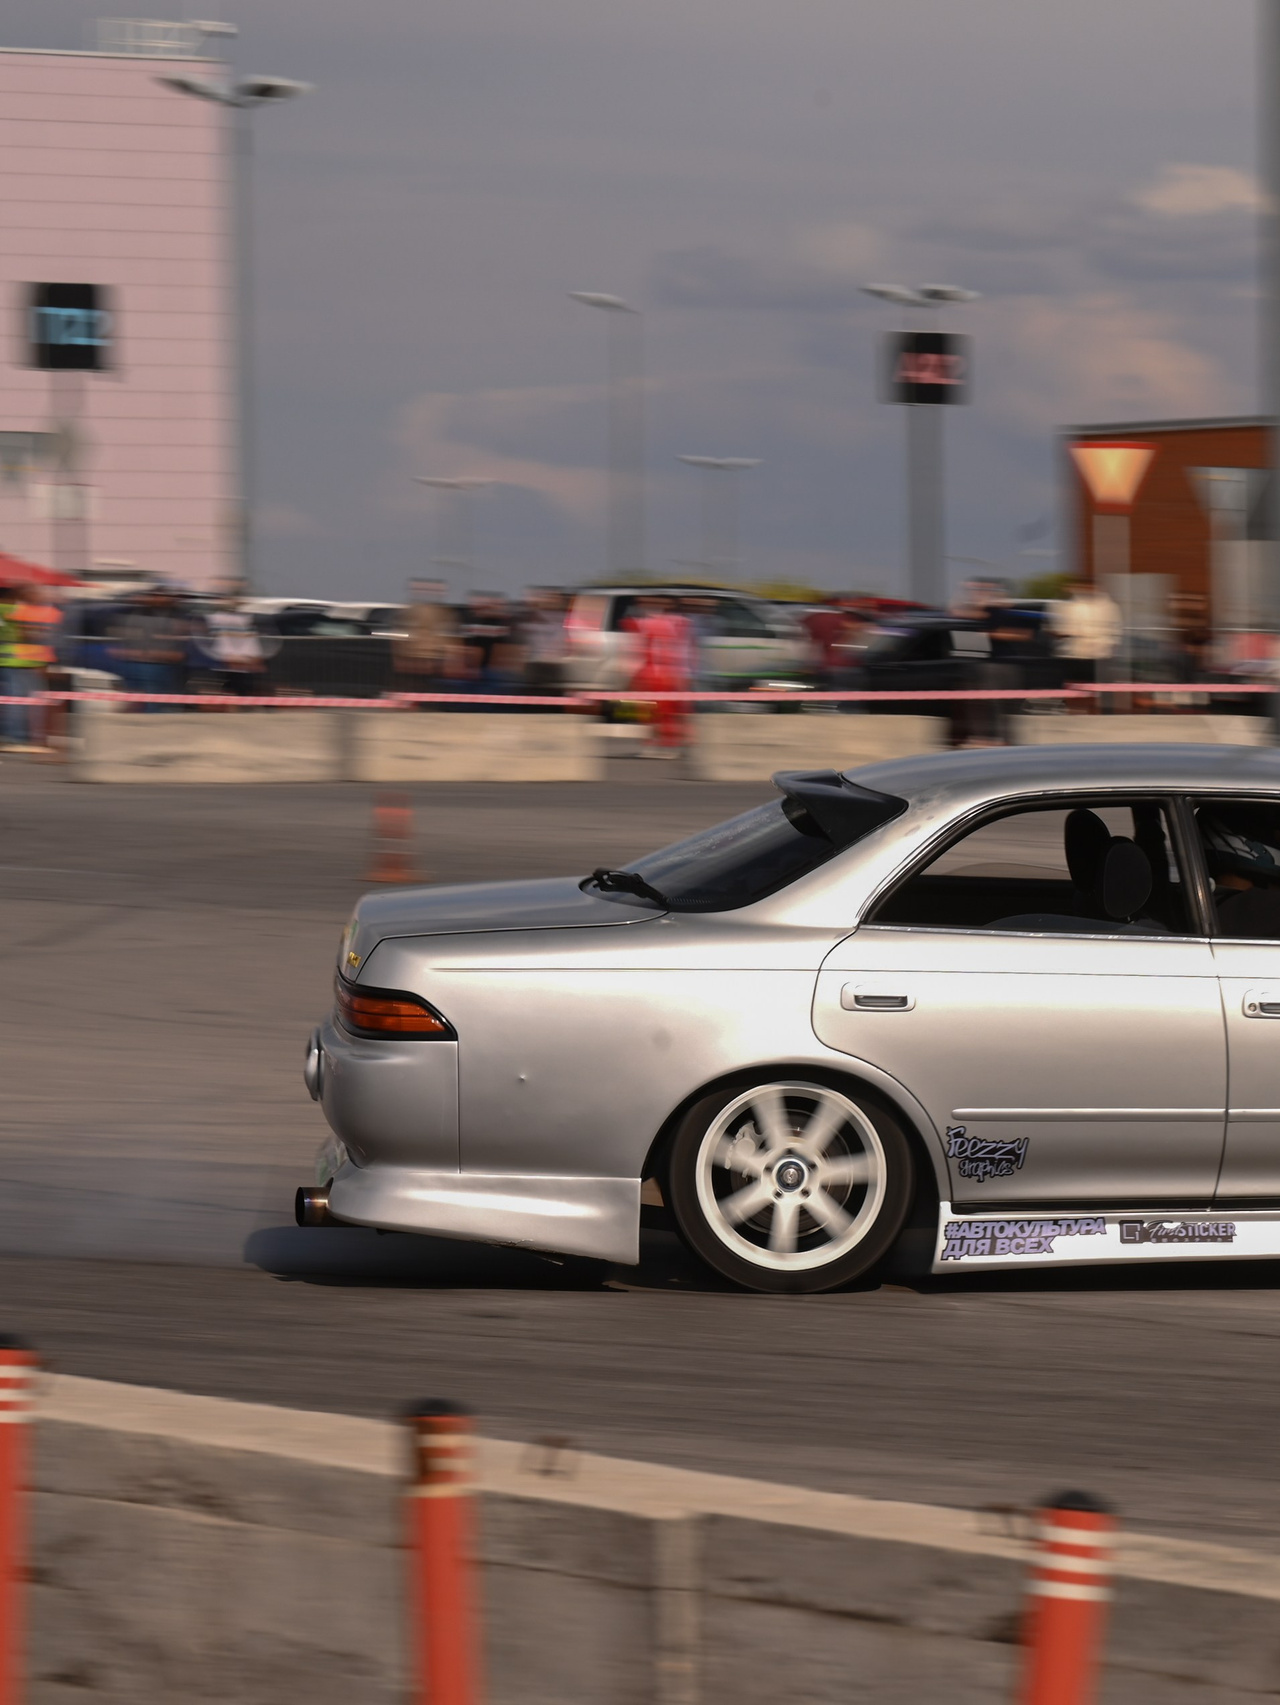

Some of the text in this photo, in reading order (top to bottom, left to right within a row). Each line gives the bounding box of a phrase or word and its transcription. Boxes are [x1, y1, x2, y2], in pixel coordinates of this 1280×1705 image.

[947, 1126, 1030, 1169] Feezzy
[941, 1237, 1054, 1259] ДЛЯ ВСЕХ
